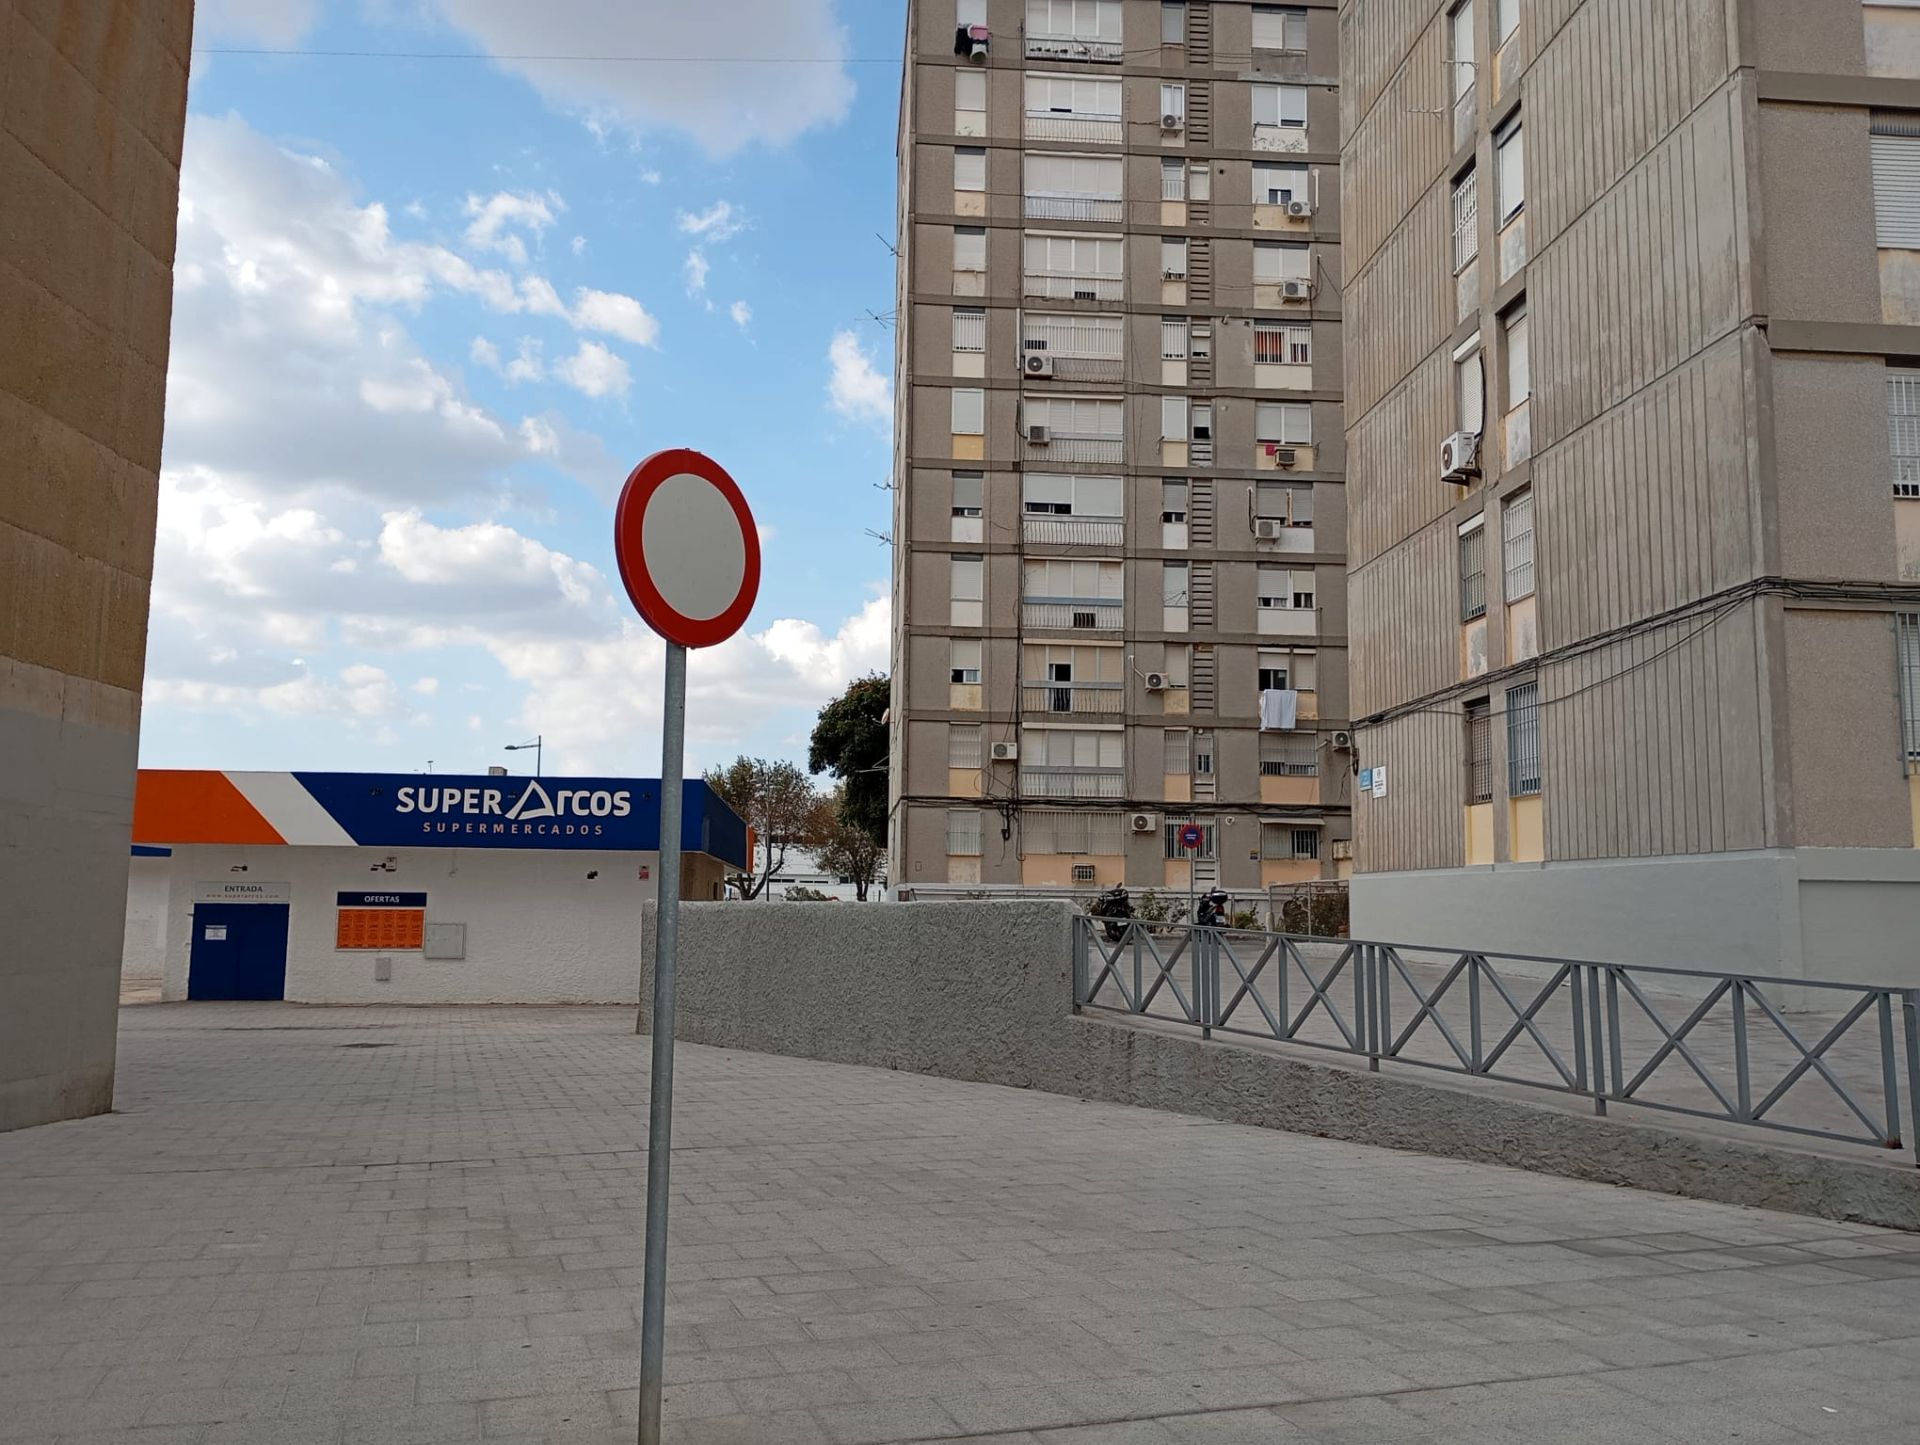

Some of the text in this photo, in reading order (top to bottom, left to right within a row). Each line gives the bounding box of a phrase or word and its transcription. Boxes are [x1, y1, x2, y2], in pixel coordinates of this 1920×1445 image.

[395, 786, 502, 815] SUPER
[422, 822, 604, 836] SUPERMERCADOS
[224, 885, 264, 893] ENTRADA
[364, 895, 400, 903] OFERTAS
